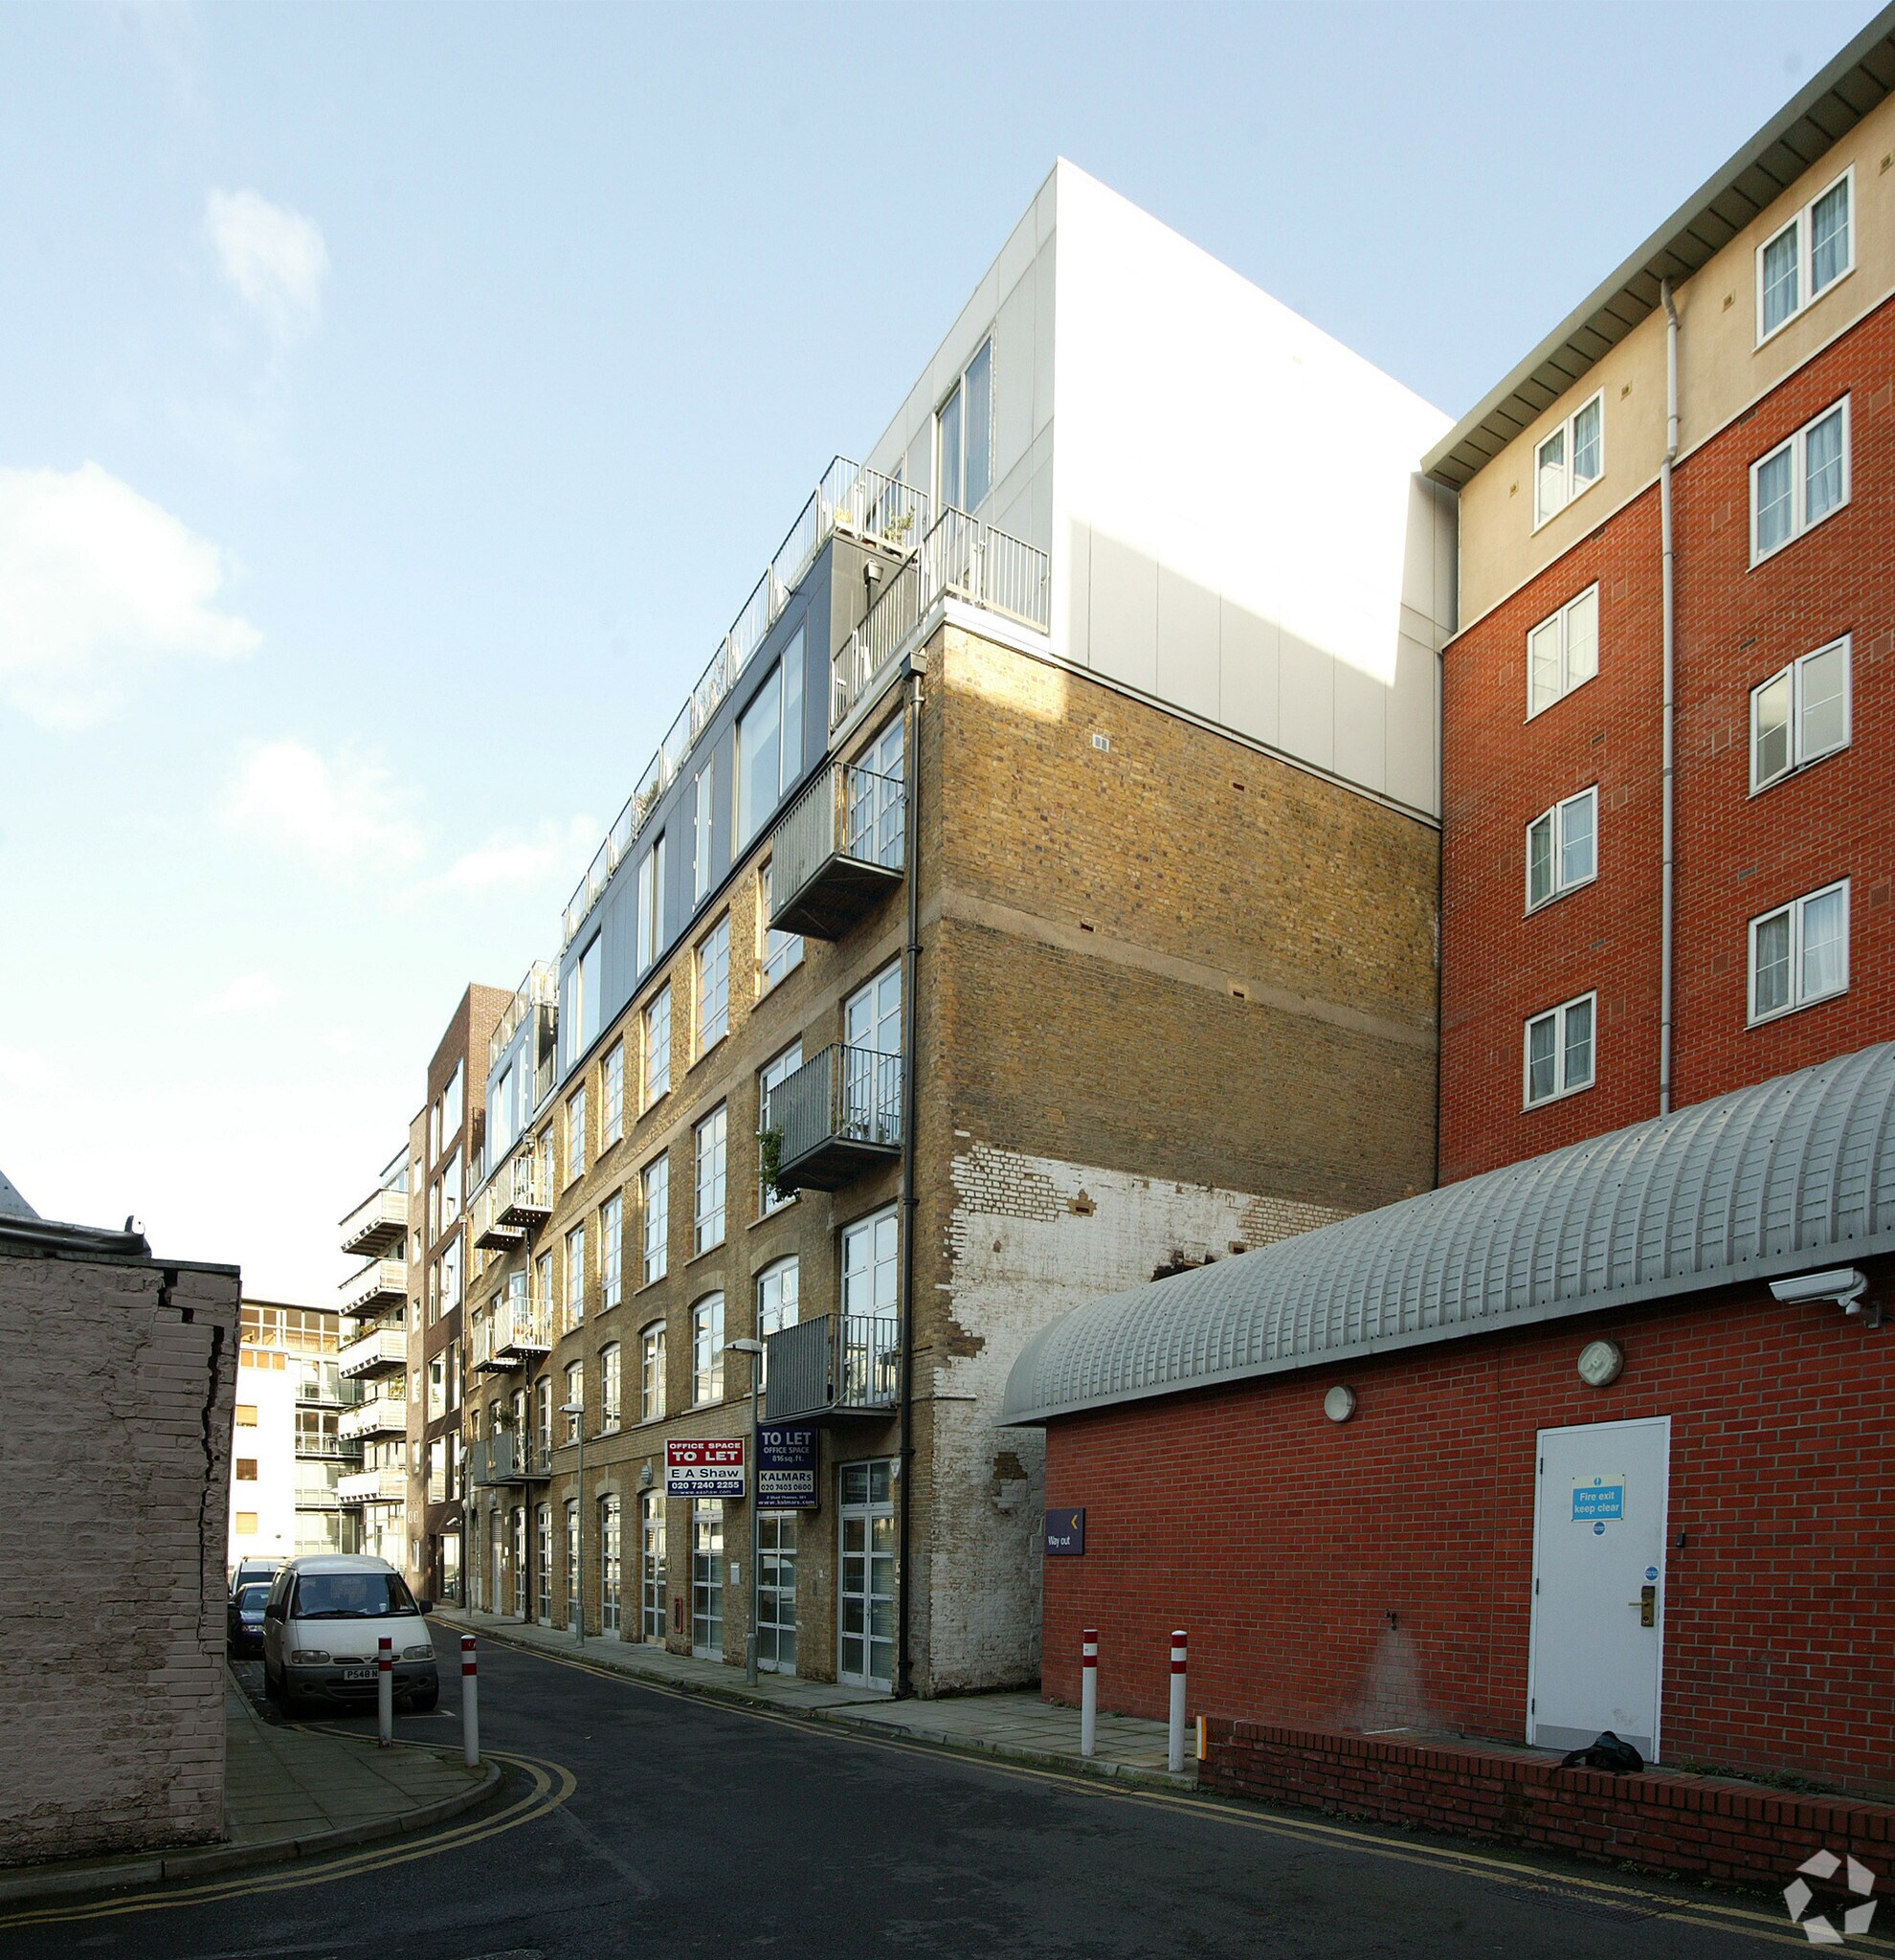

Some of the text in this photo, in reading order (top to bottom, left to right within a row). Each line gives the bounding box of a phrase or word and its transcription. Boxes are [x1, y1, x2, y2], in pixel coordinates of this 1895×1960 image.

[762, 1432, 812, 1445] TO LET
[672, 1451, 738, 1461] TO LET
[672, 1468, 739, 1478] E A Shaw
[1579, 1491, 1615, 1502] Fire exit
[1574, 1503, 1619, 1515] keep clear
[1048, 1536, 1071, 1548] Way out
[347, 1670, 370, 1679] P548
